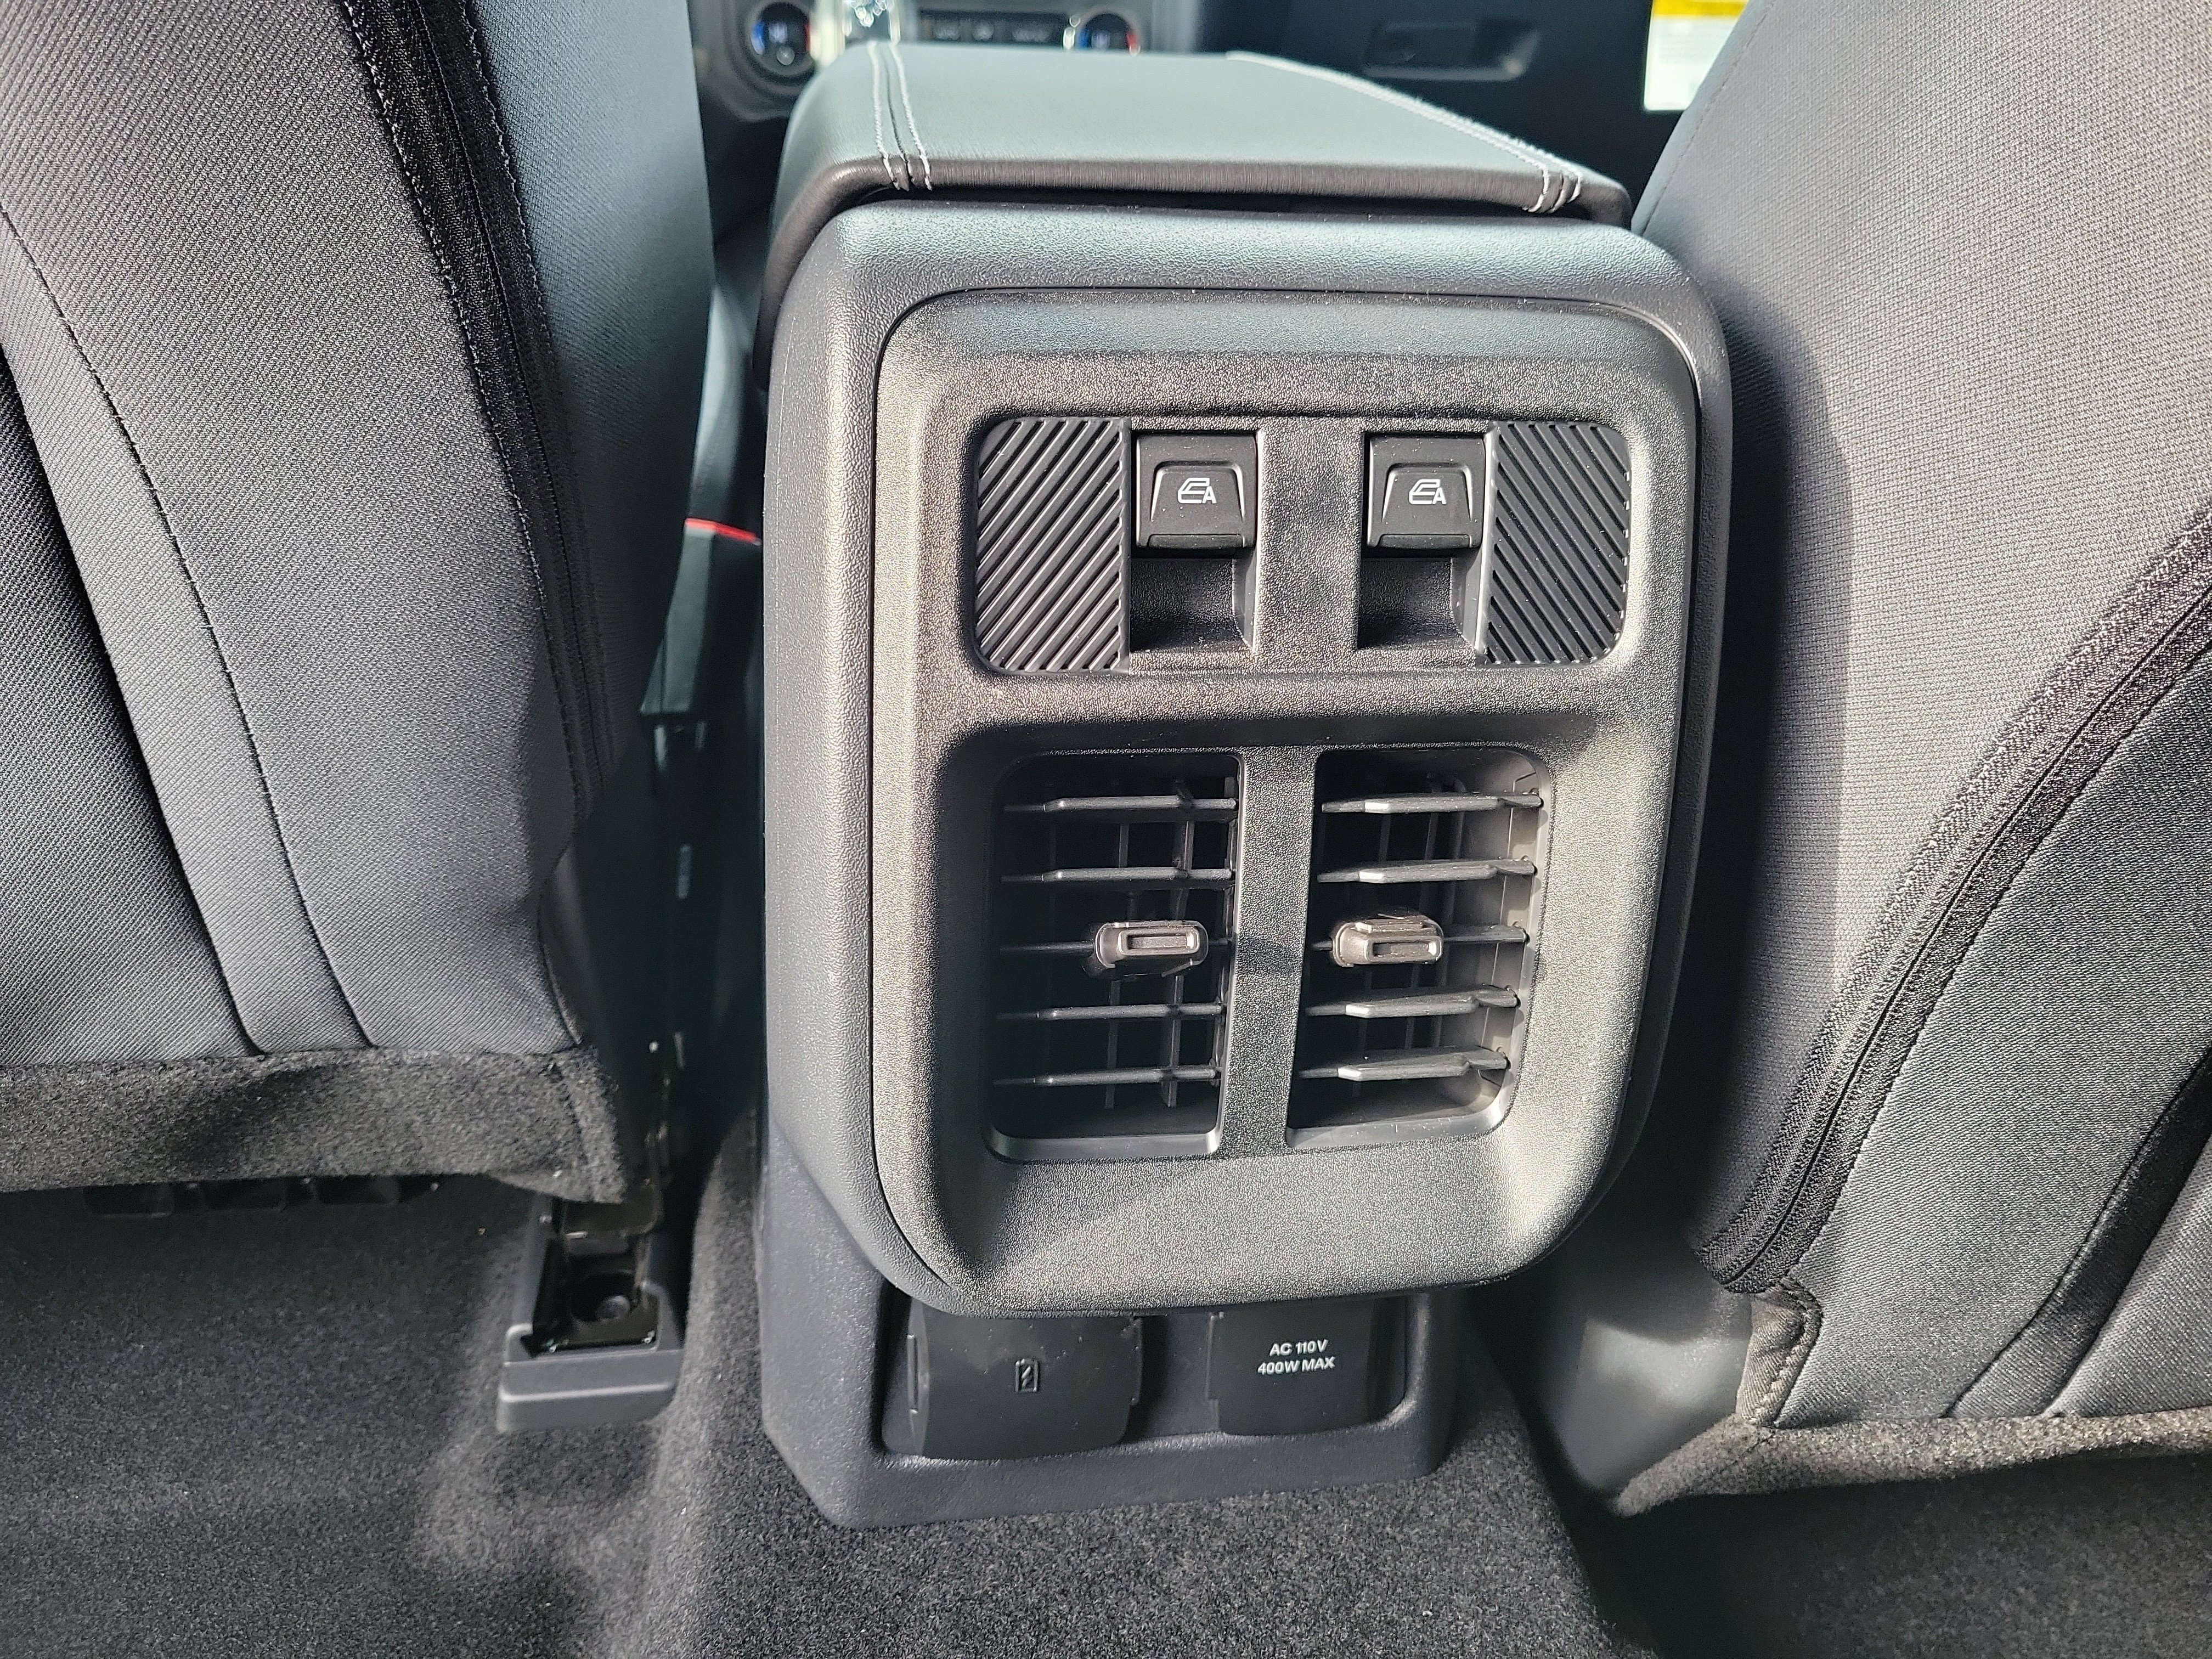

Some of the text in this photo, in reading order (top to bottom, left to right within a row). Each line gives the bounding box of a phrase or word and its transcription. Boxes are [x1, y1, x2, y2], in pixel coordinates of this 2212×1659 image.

[1269, 1339, 1329, 1356] AC 110V
[1257, 1356, 1335, 1375] 400W MAX
